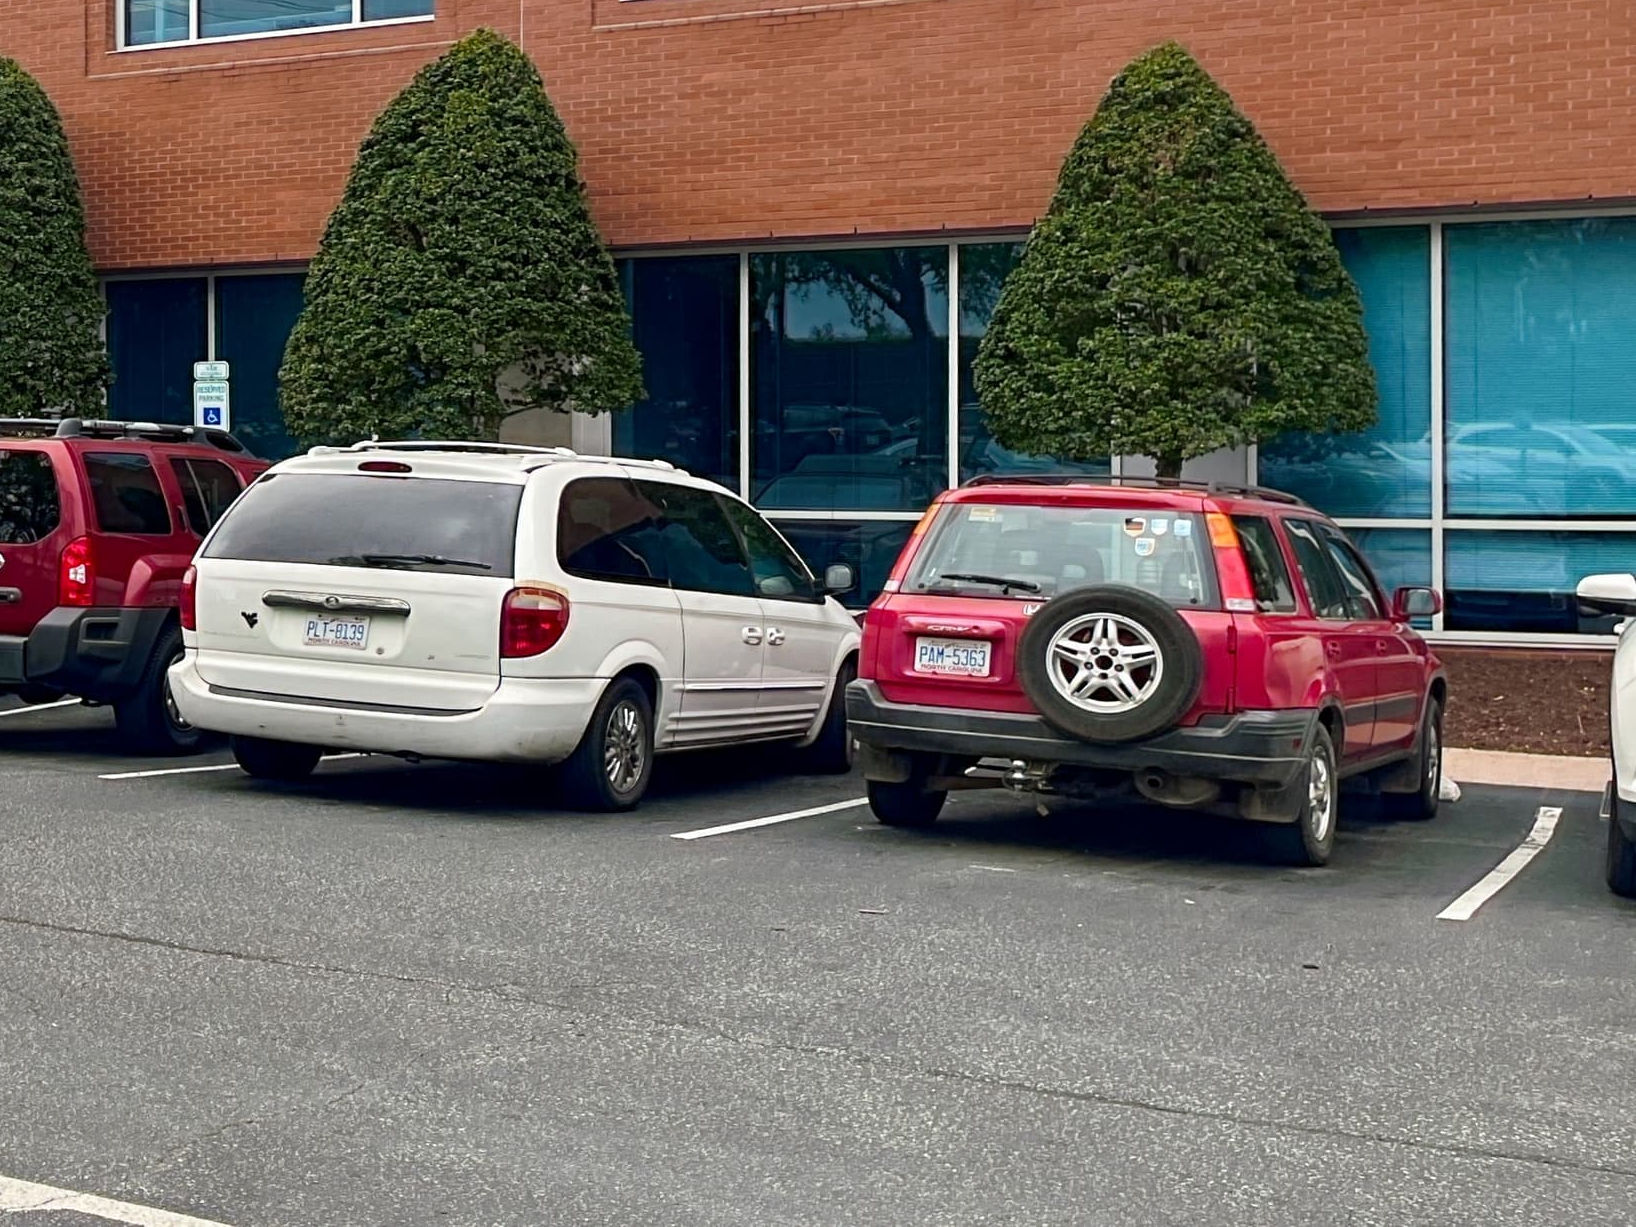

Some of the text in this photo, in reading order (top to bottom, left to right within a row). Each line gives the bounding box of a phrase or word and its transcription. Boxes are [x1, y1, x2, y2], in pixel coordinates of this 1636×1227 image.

[307, 621, 365, 641] PLT-8139
[919, 646, 986, 668] PAM-5363
[948, 665, 982, 673] CAROLINA
